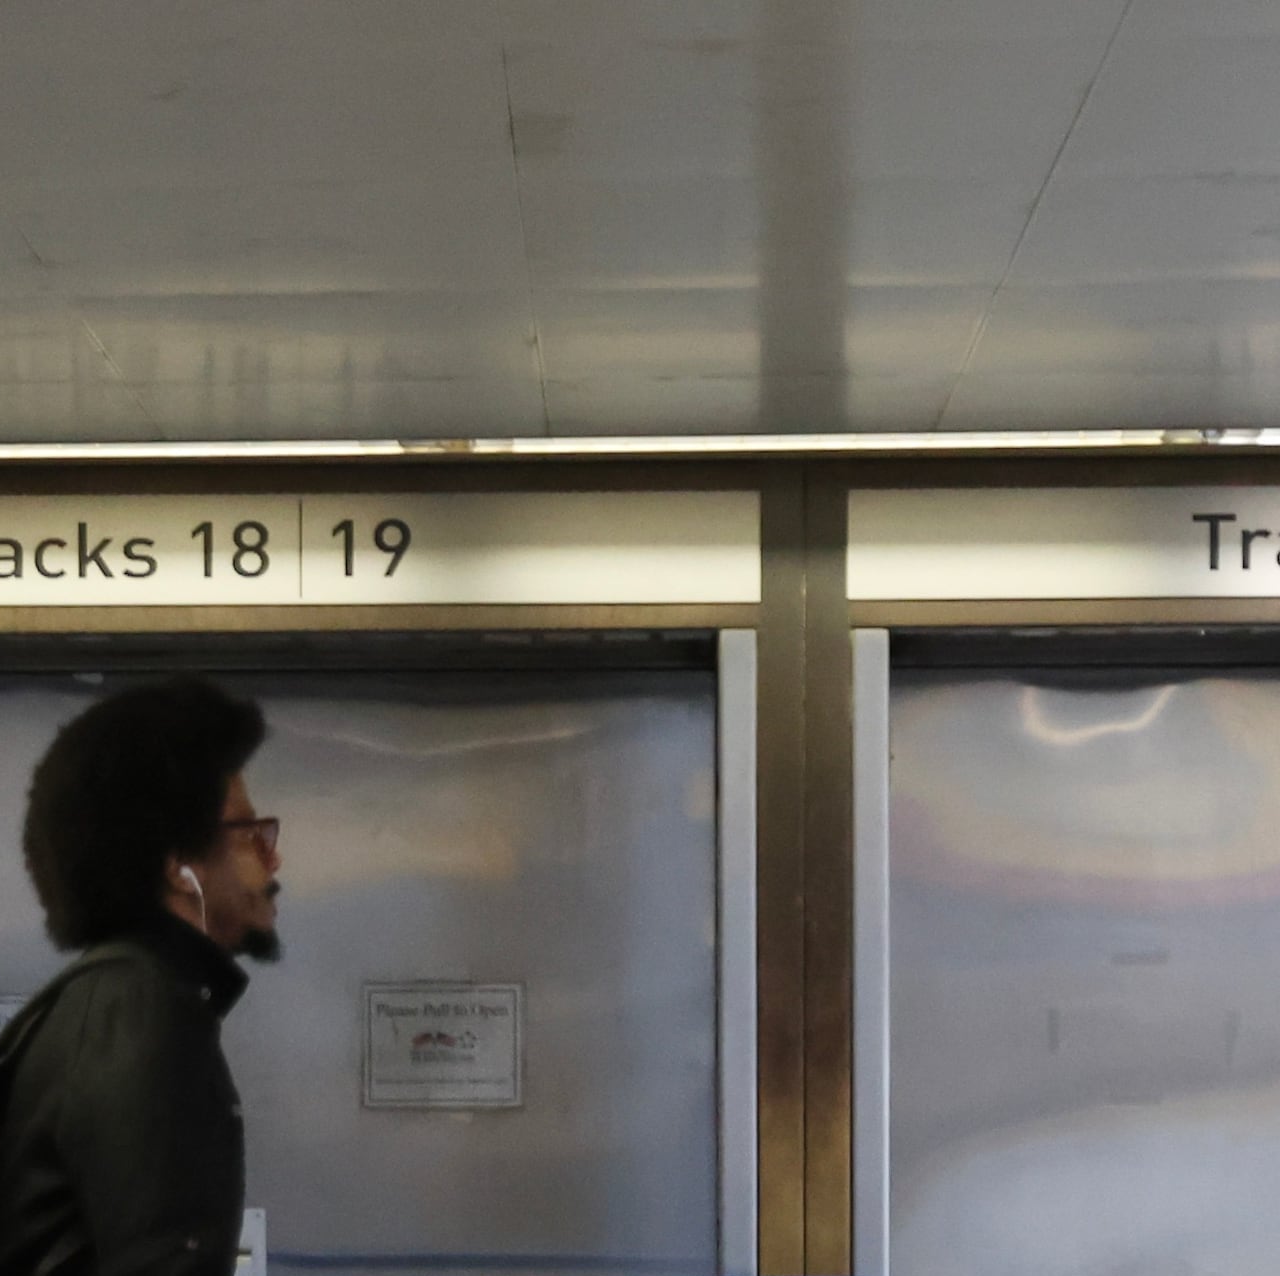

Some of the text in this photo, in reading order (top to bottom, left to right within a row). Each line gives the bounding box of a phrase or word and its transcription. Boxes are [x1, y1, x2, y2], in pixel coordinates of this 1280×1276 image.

[191, 520, 271, 578] 18
[332, 518, 413, 577] 19
[375, 1002, 419, 1018] Please
